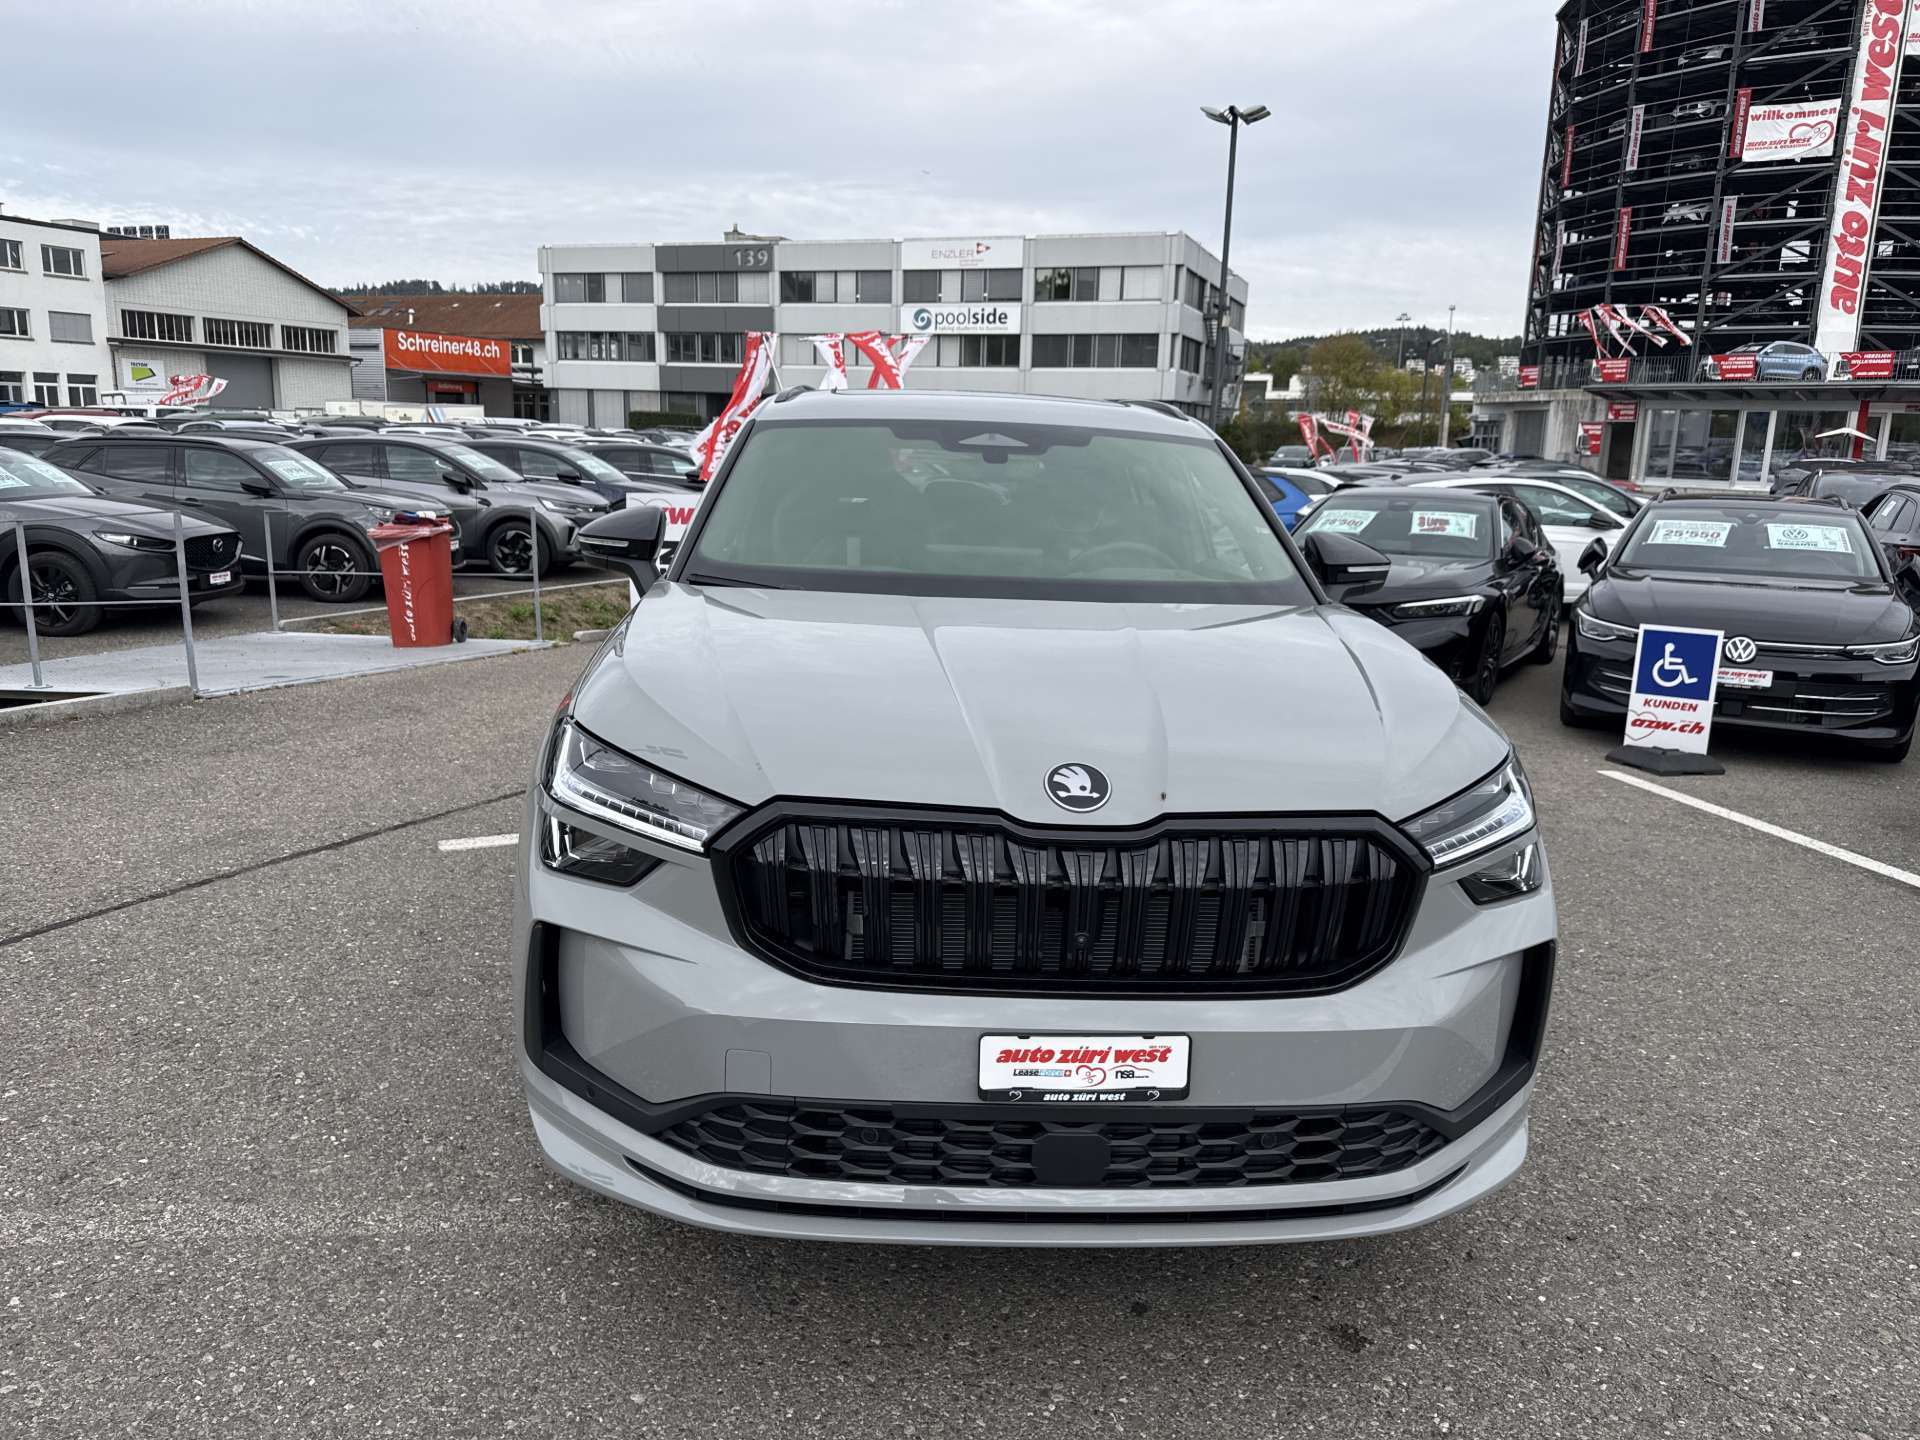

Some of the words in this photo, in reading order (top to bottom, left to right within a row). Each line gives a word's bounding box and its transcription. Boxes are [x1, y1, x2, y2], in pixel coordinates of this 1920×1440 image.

[1861, 0, 1904, 100] west
[1751, 107, 1837, 121] willkommen
[1789, 136, 1813, 144] west
[1844, 107, 1886, 209] züri
[733, 250, 769, 266] 139
[931, 249, 974, 259] ENZLER
[1831, 211, 1868, 315] auto
[934, 307, 1008, 331] poolside
[397, 332, 500, 359] Schreiner48.ch
[1643, 698, 1698, 712] KUNDEN
[1631, 718, 1705, 735] azw.ch
[996, 1046, 1056, 1063] auto
[1055, 1046, 1113, 1064] züri
[1114, 1047, 1172, 1063] west
[1115, 1069, 1135, 1079] nsa
[1043, 1092, 1070, 1101] auto
[1072, 1092, 1097, 1101] züri
[1099, 1092, 1126, 1101] west
